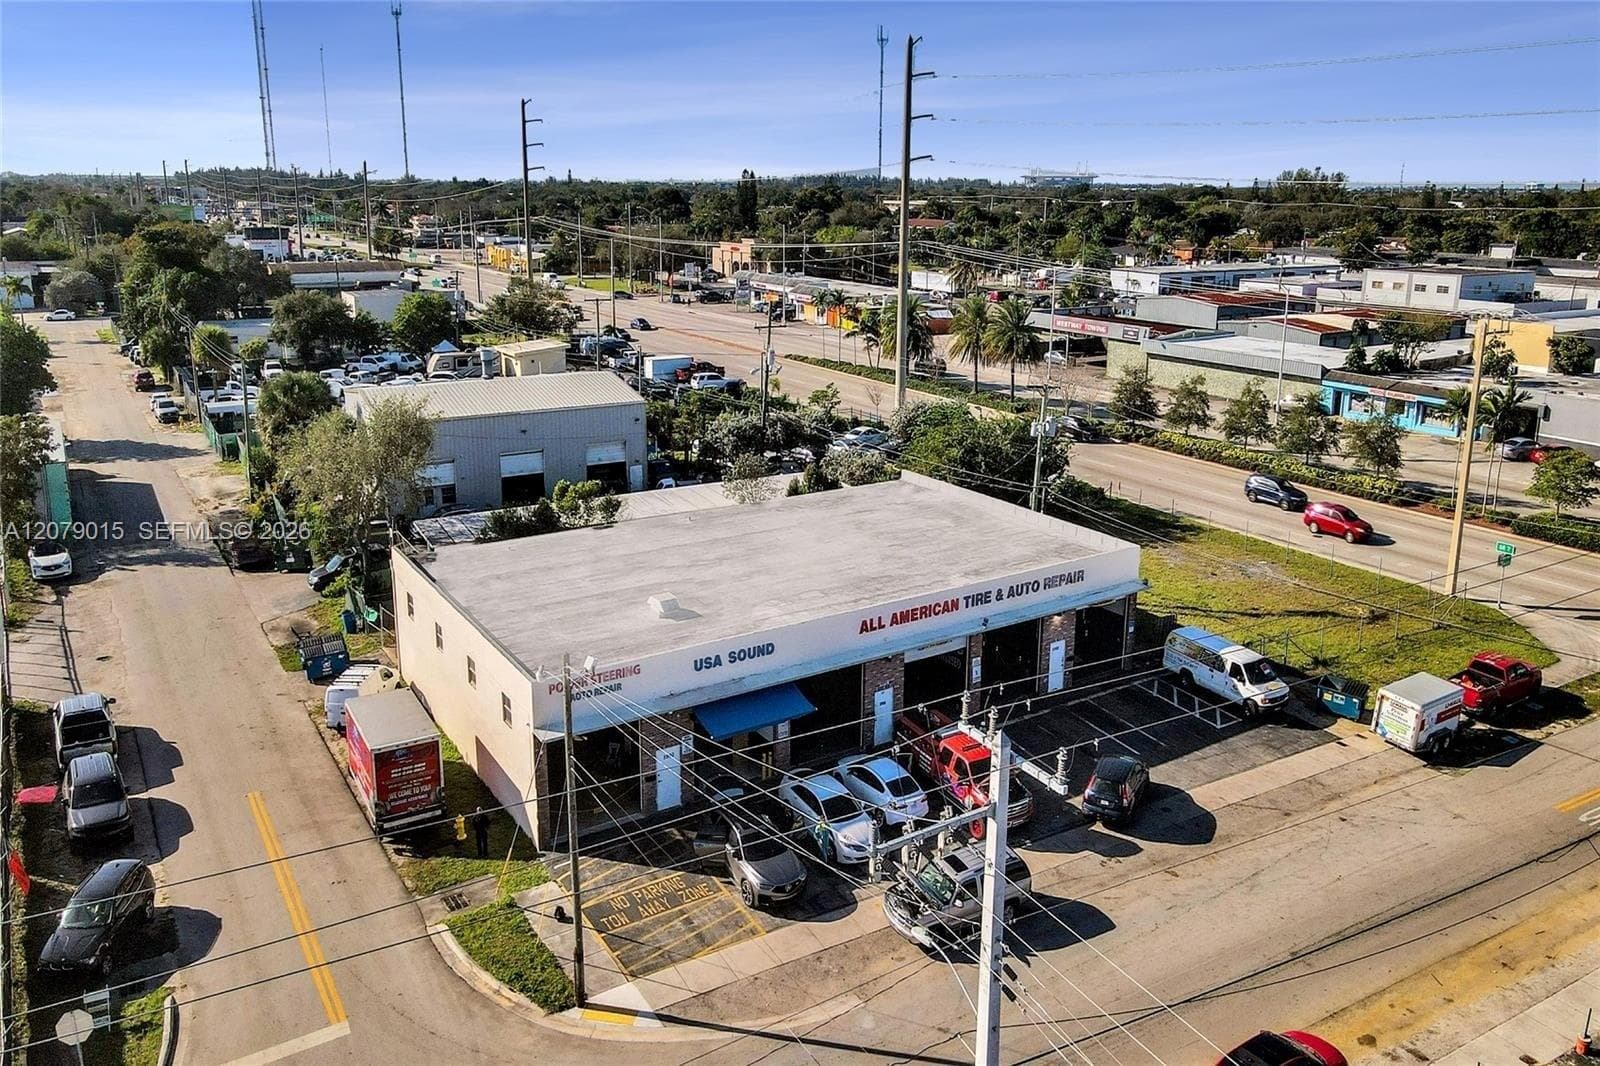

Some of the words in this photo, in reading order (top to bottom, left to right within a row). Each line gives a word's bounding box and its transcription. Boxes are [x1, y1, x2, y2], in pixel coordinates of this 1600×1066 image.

[859, 616, 886, 635] ALL
[889, 598, 960, 627] AMERICAN
[963, 590, 992, 609] TIRE
[995, 588, 1004, 602] &
[1006, 580, 1040, 599] AUTO
[1043, 569, 1085, 591] REPAIR
[590, 664, 641, 685] STEERING
[693, 654, 722, 672] USA
[728, 642, 775, 664] SOUND
[600, 911, 631, 931] TOW
[638, 896, 673, 919] AWAY
[678, 883, 715, 904] ZONE
[608, 894, 630, 912] NO
[632, 876, 686, 904] PARKING
